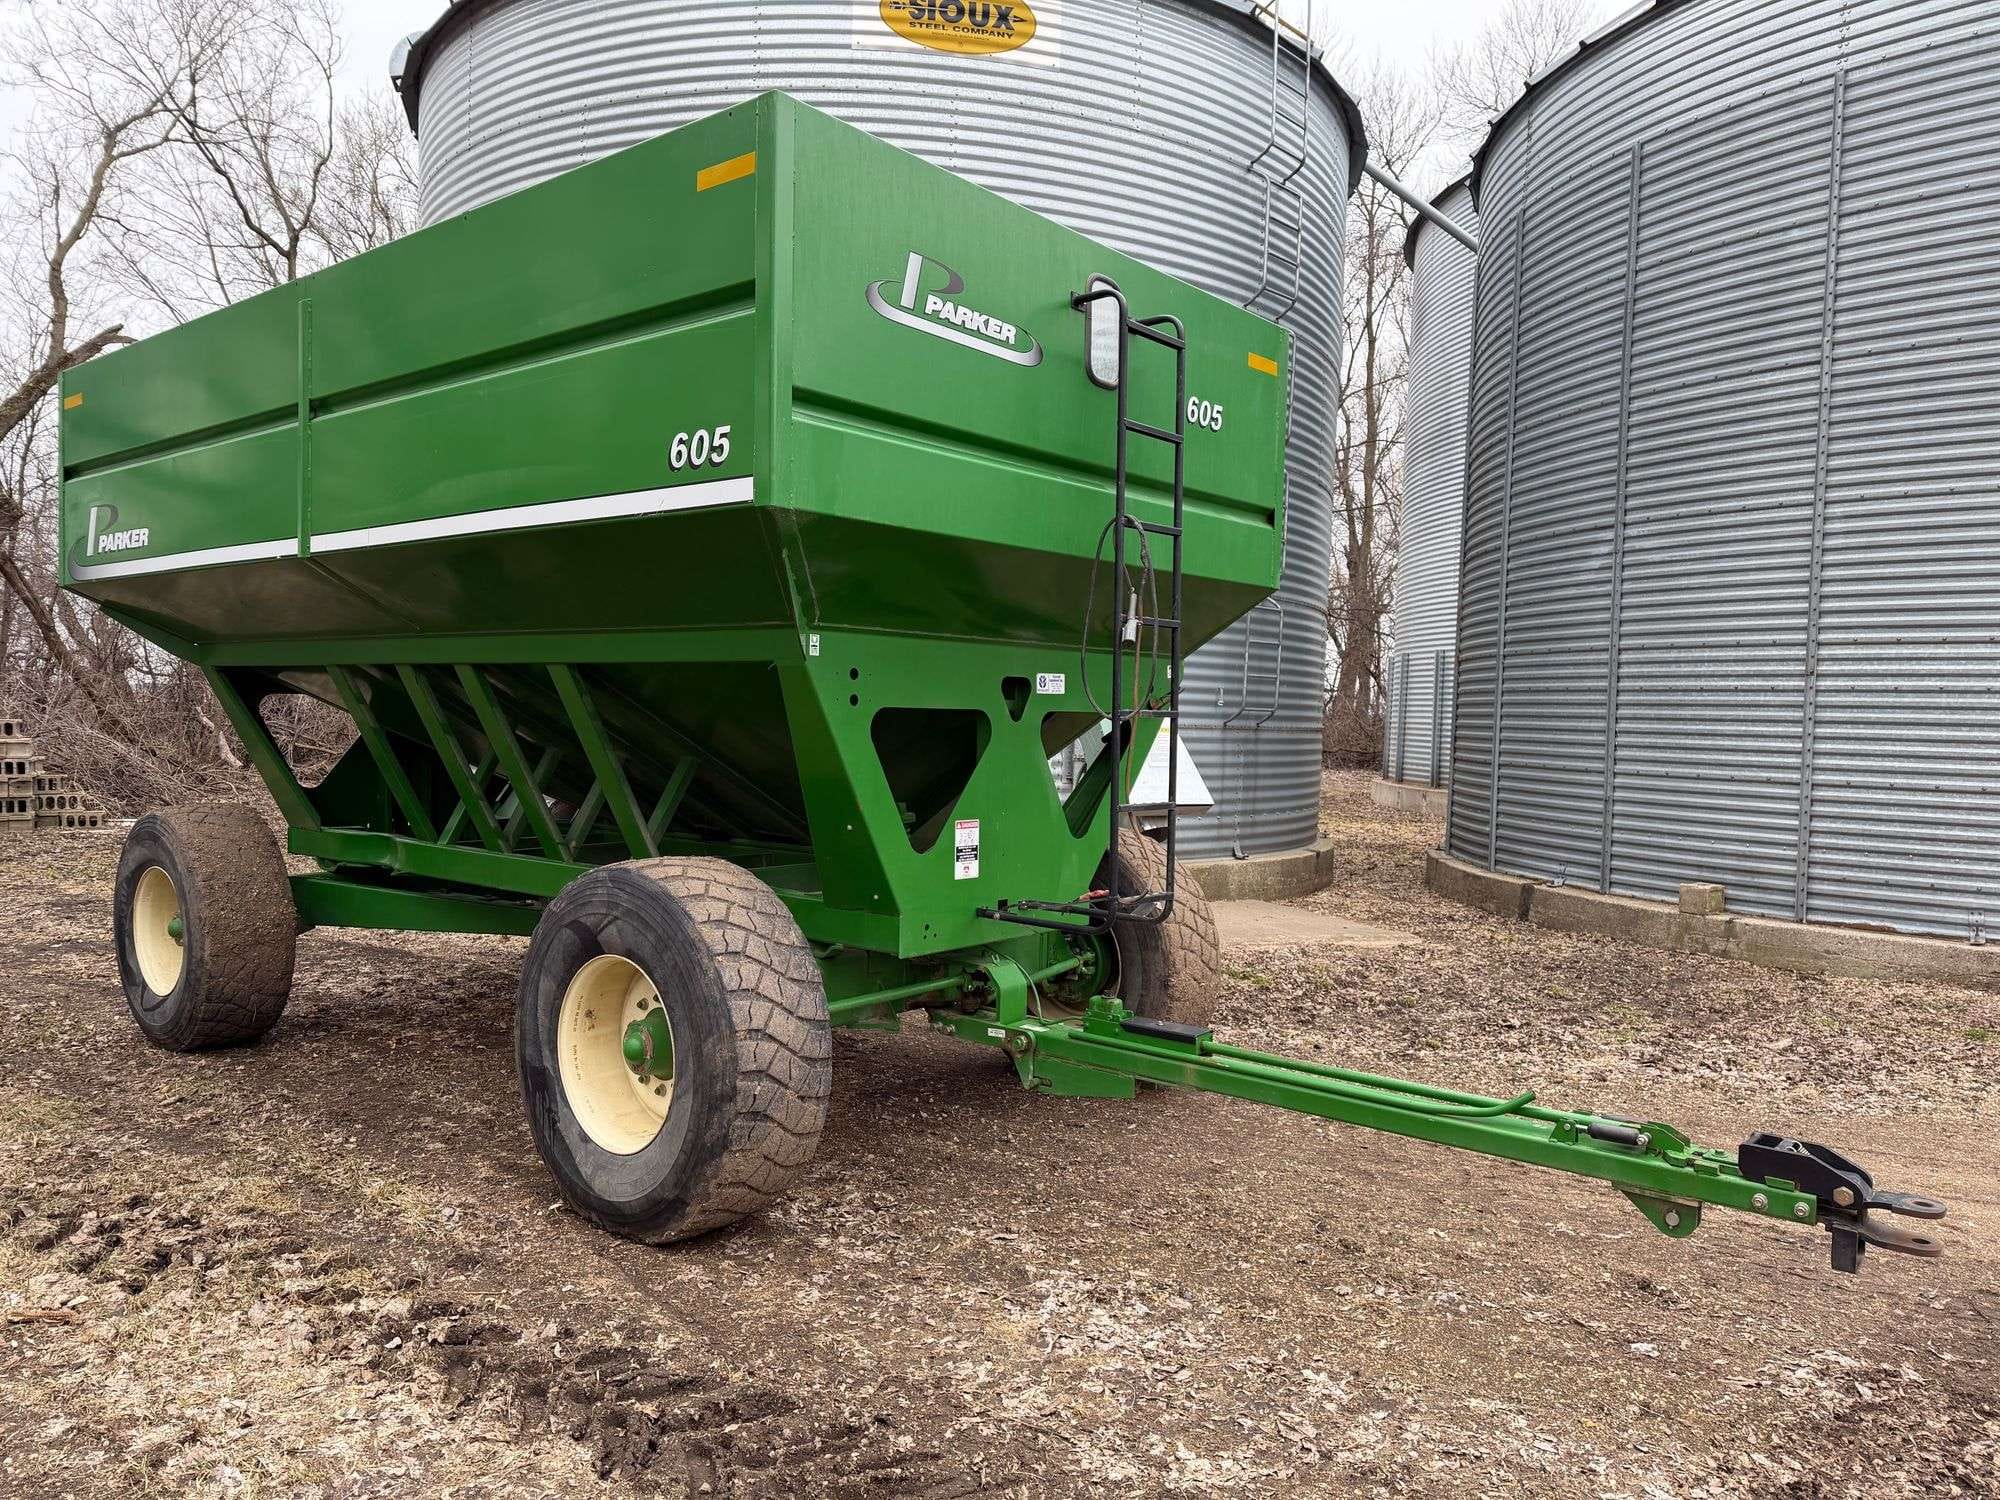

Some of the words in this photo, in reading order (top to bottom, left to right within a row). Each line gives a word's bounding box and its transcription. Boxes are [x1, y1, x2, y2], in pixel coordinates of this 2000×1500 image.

[908, 0, 1015, 31] SIOUX
[909, 21, 948, 31] STEEL
[953, 25, 1014, 40] COMPANY
[924, 293, 1018, 345] PARKER
[1187, 396, 1223, 432] 605
[669, 425, 731, 471] 605
[98, 528, 149, 553] PARKER
